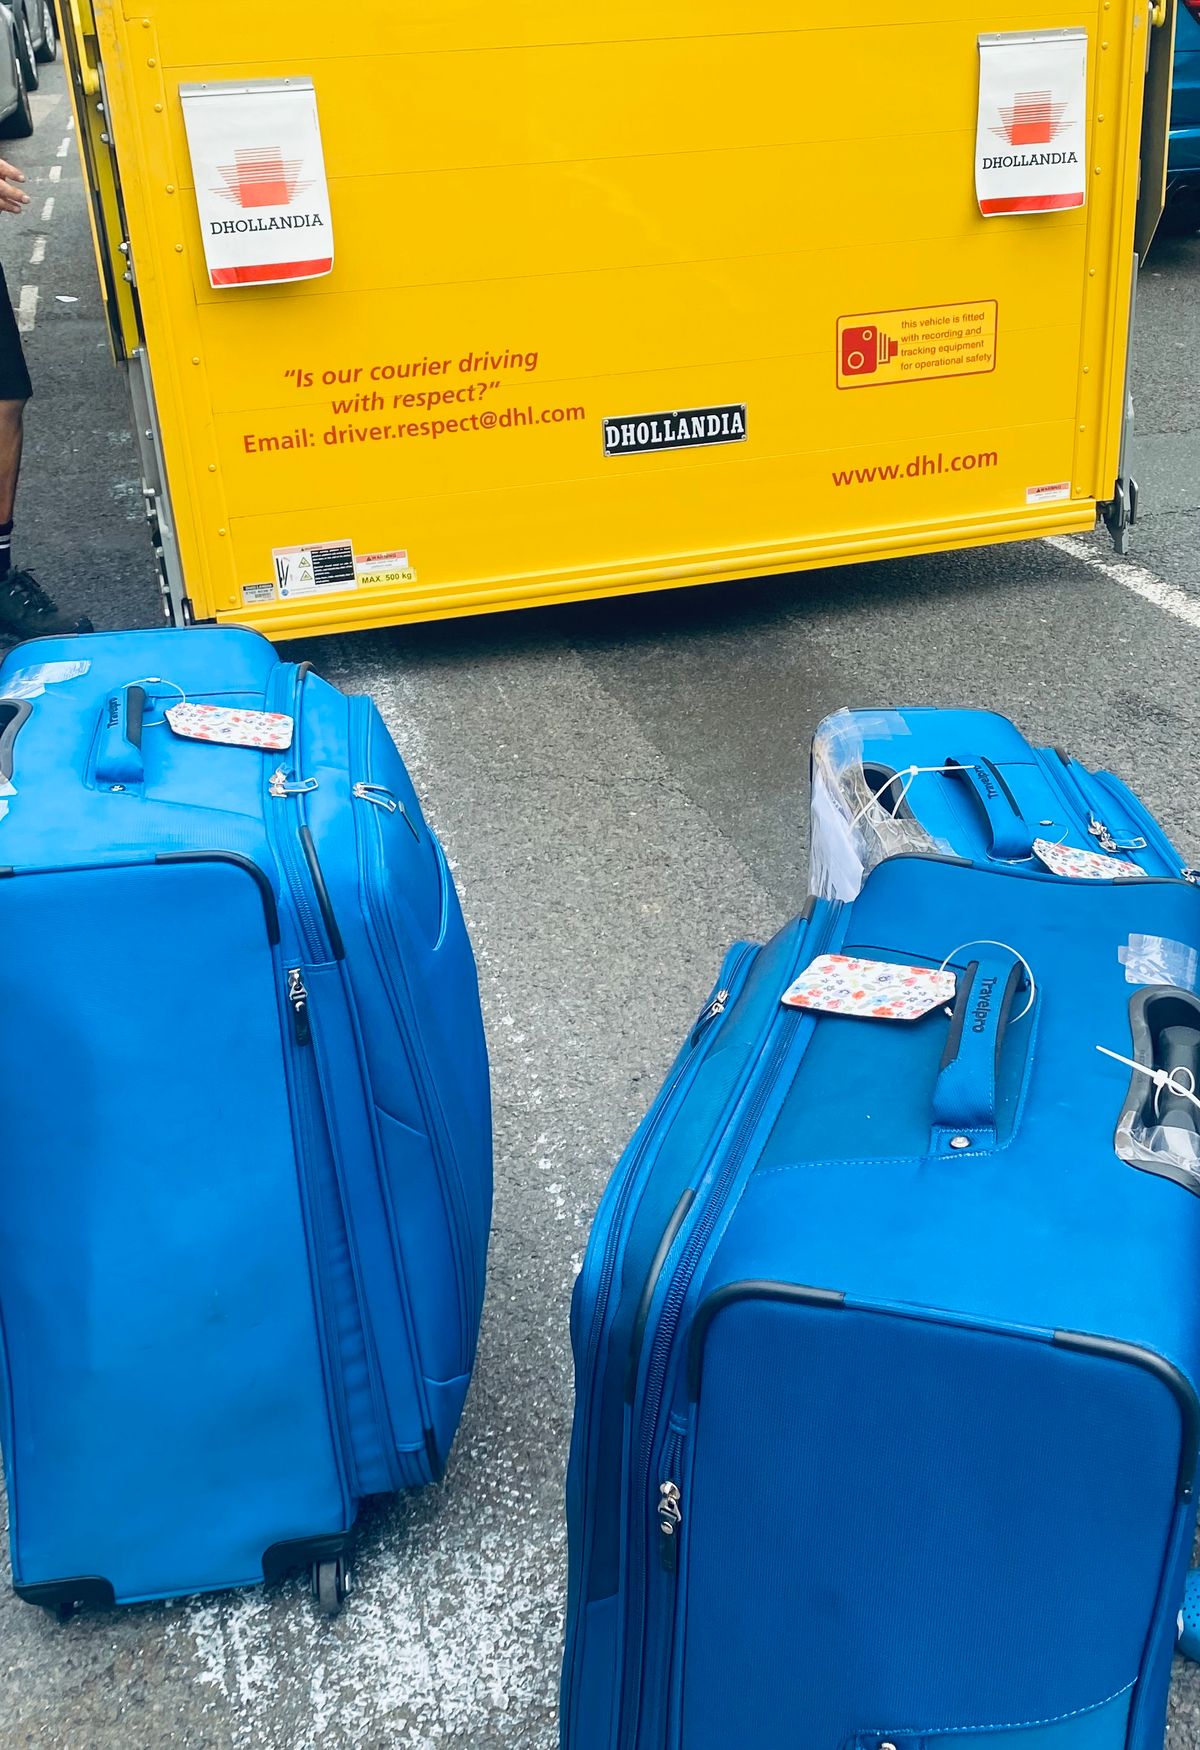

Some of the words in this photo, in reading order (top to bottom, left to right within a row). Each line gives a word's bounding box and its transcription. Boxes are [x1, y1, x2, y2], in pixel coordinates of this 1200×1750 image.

[982, 151, 1078, 170] DHOLLANDIA
[210, 213, 324, 235] DHOLLANDIA
[901, 319, 918, 329] this
[920, 316, 951, 327] vehicle
[952, 314, 960, 323] is
[962, 311, 985, 322] fitted
[900, 332, 919, 343] with
[922, 327, 963, 342] recording
[965, 326, 982, 336] and
[900, 343, 936, 357] tracking
[938, 339, 984, 354] equipment
[322, 366, 363, 385] our
[370, 356, 452, 382] courier
[458, 348, 539, 373] driving
[900, 361, 912, 371] for
[914, 355, 964, 371] operational
[966, 352, 992, 366] safety
[331, 390, 385, 415] with
[243, 427, 316, 454] Email:
[322, 404, 586, 446] driver.respect@dhl.com
[605, 411, 745, 448] DHOLLANDIA
[831, 450, 998, 487] www.dhl.com
[385, 573, 400, 582] 500
[401, 572, 412, 581] kg
[972, 976, 998, 1033] Travelpro
